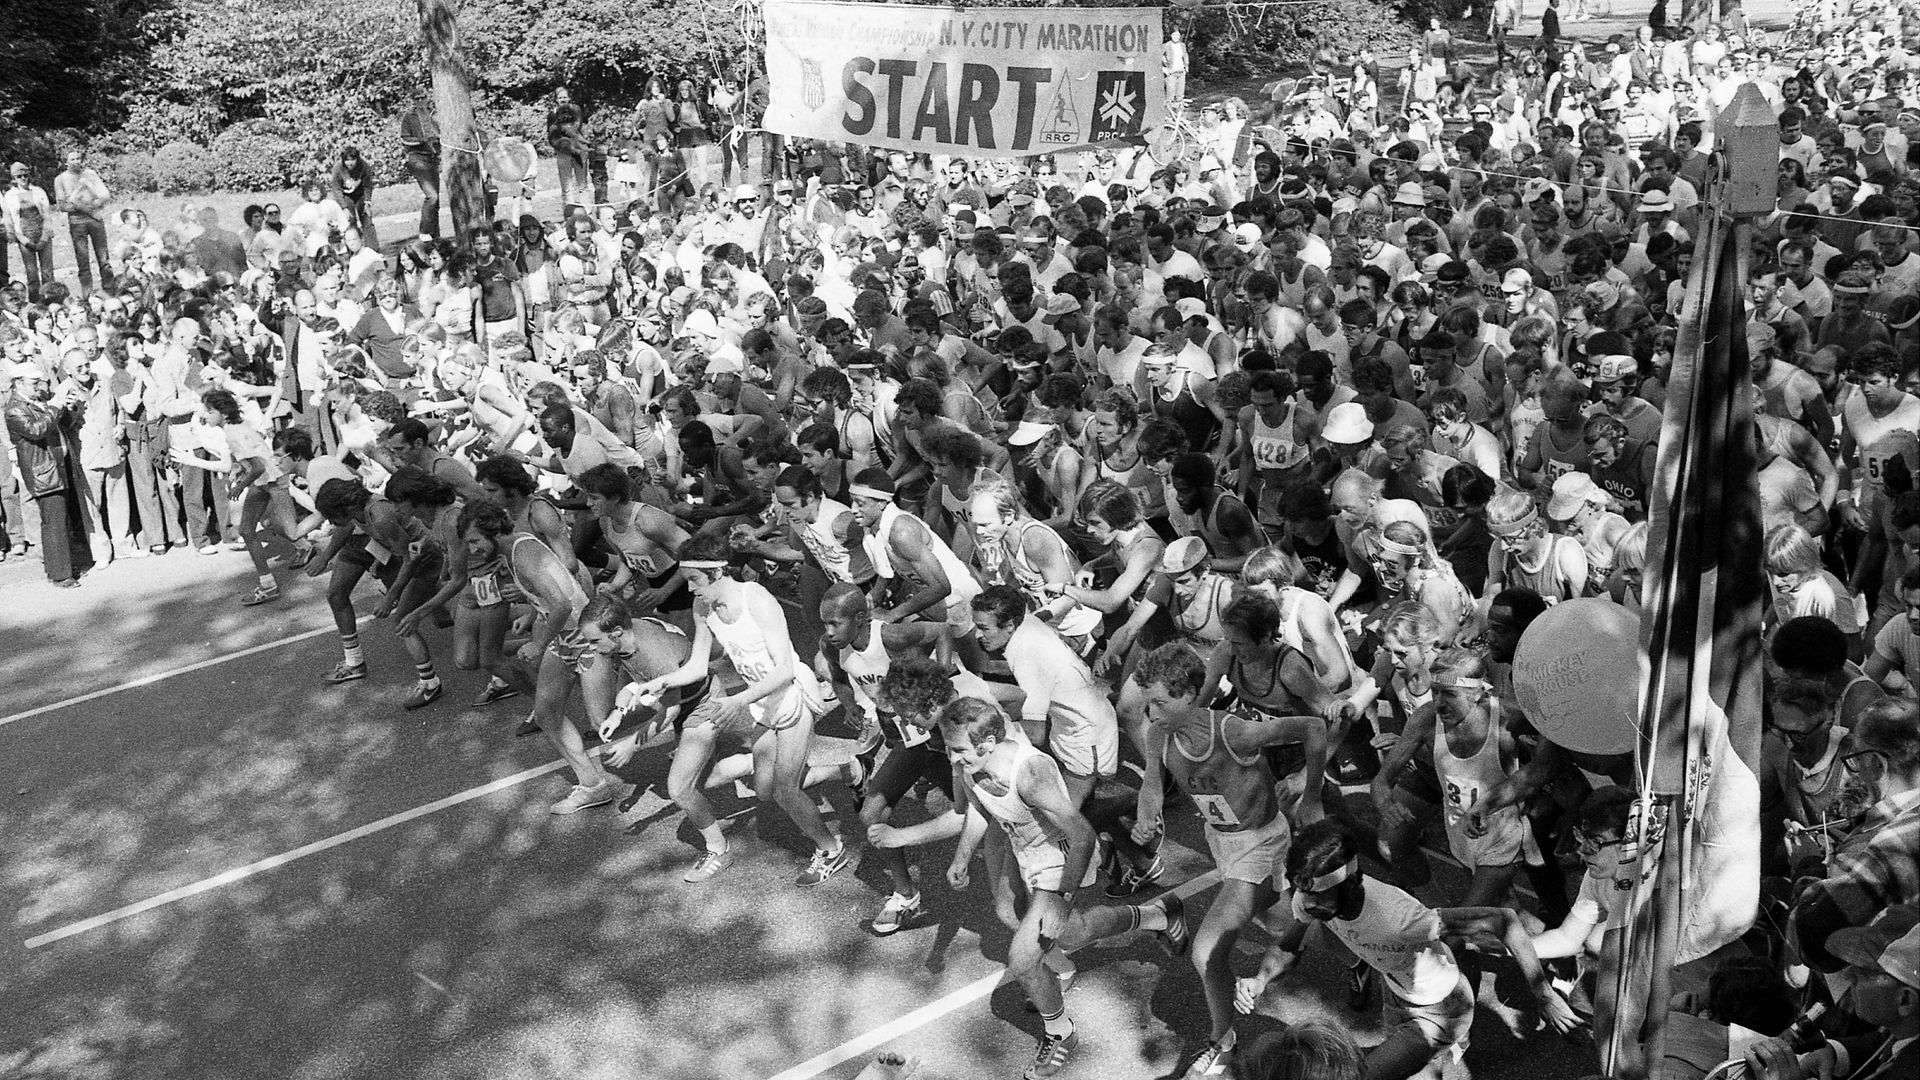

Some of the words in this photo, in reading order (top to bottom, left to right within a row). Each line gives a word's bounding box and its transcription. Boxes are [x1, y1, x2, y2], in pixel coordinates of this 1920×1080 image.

[1037, 23, 1149, 52] MARATHON
[842, 56, 1052, 151] START
[1045, 133, 1071, 142] RRC
[1257, 441, 1287, 464] 128
[1604, 479, 1636, 498] OHIO
[1533, 653, 1587, 682] MICKEY
[1537, 667, 1590, 698] MOUSE
[1208, 801, 1226, 821] 4
